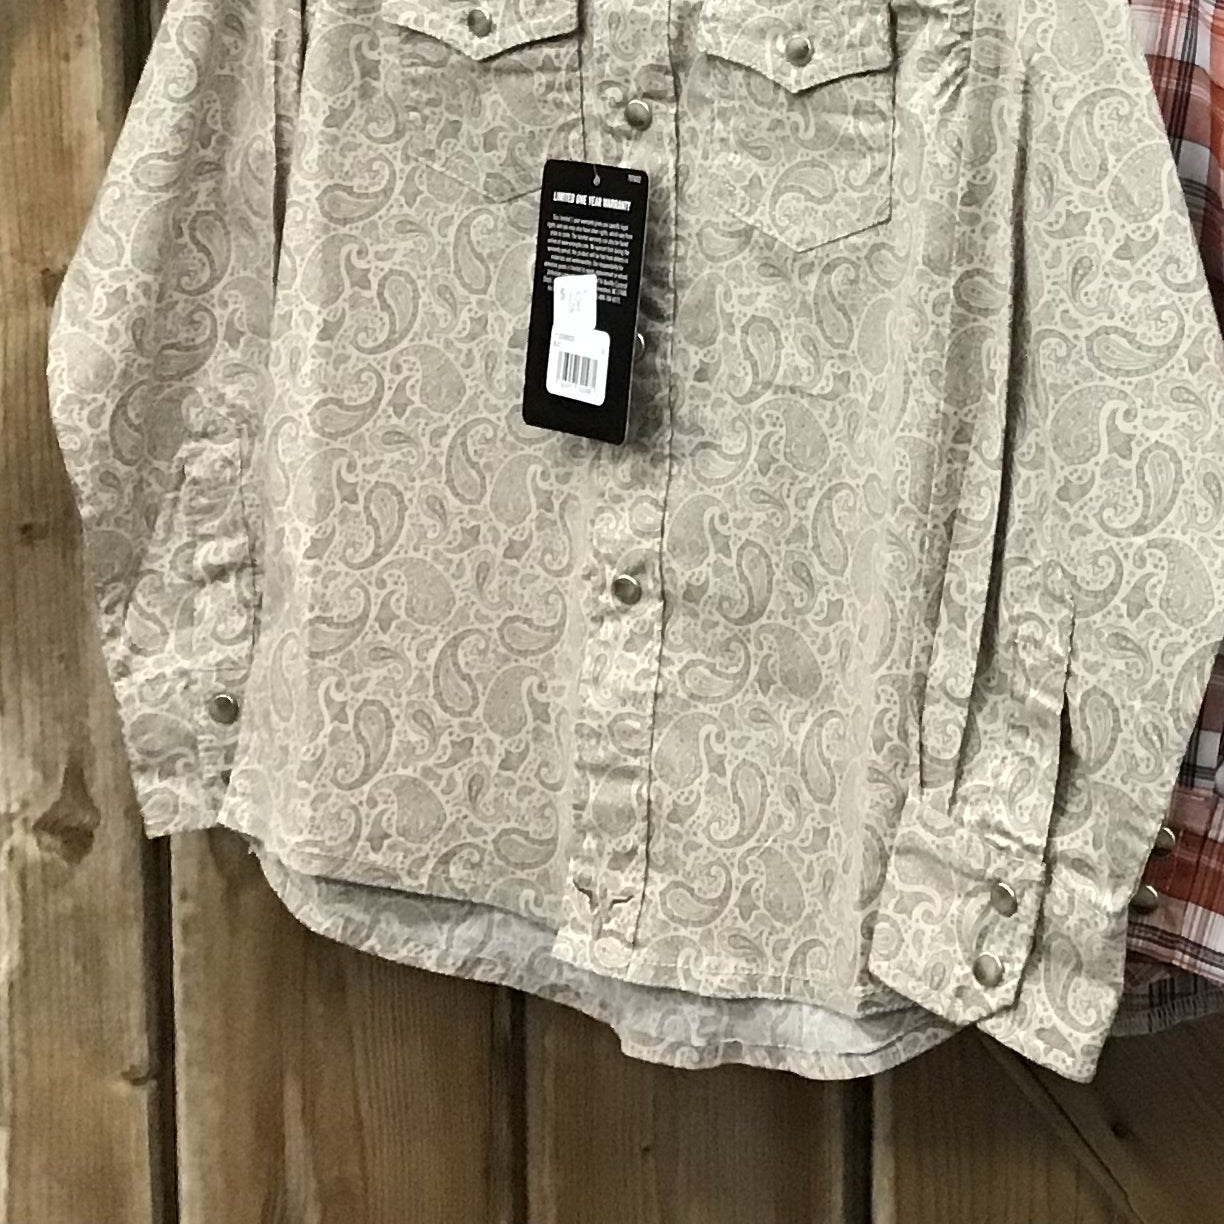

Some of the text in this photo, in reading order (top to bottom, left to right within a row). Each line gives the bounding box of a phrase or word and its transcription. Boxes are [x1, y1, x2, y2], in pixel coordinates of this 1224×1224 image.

[576, 194, 587, 206] ONE
[588, 196, 602, 207] YEAR
[603, 198, 631, 211] WARRANTY
